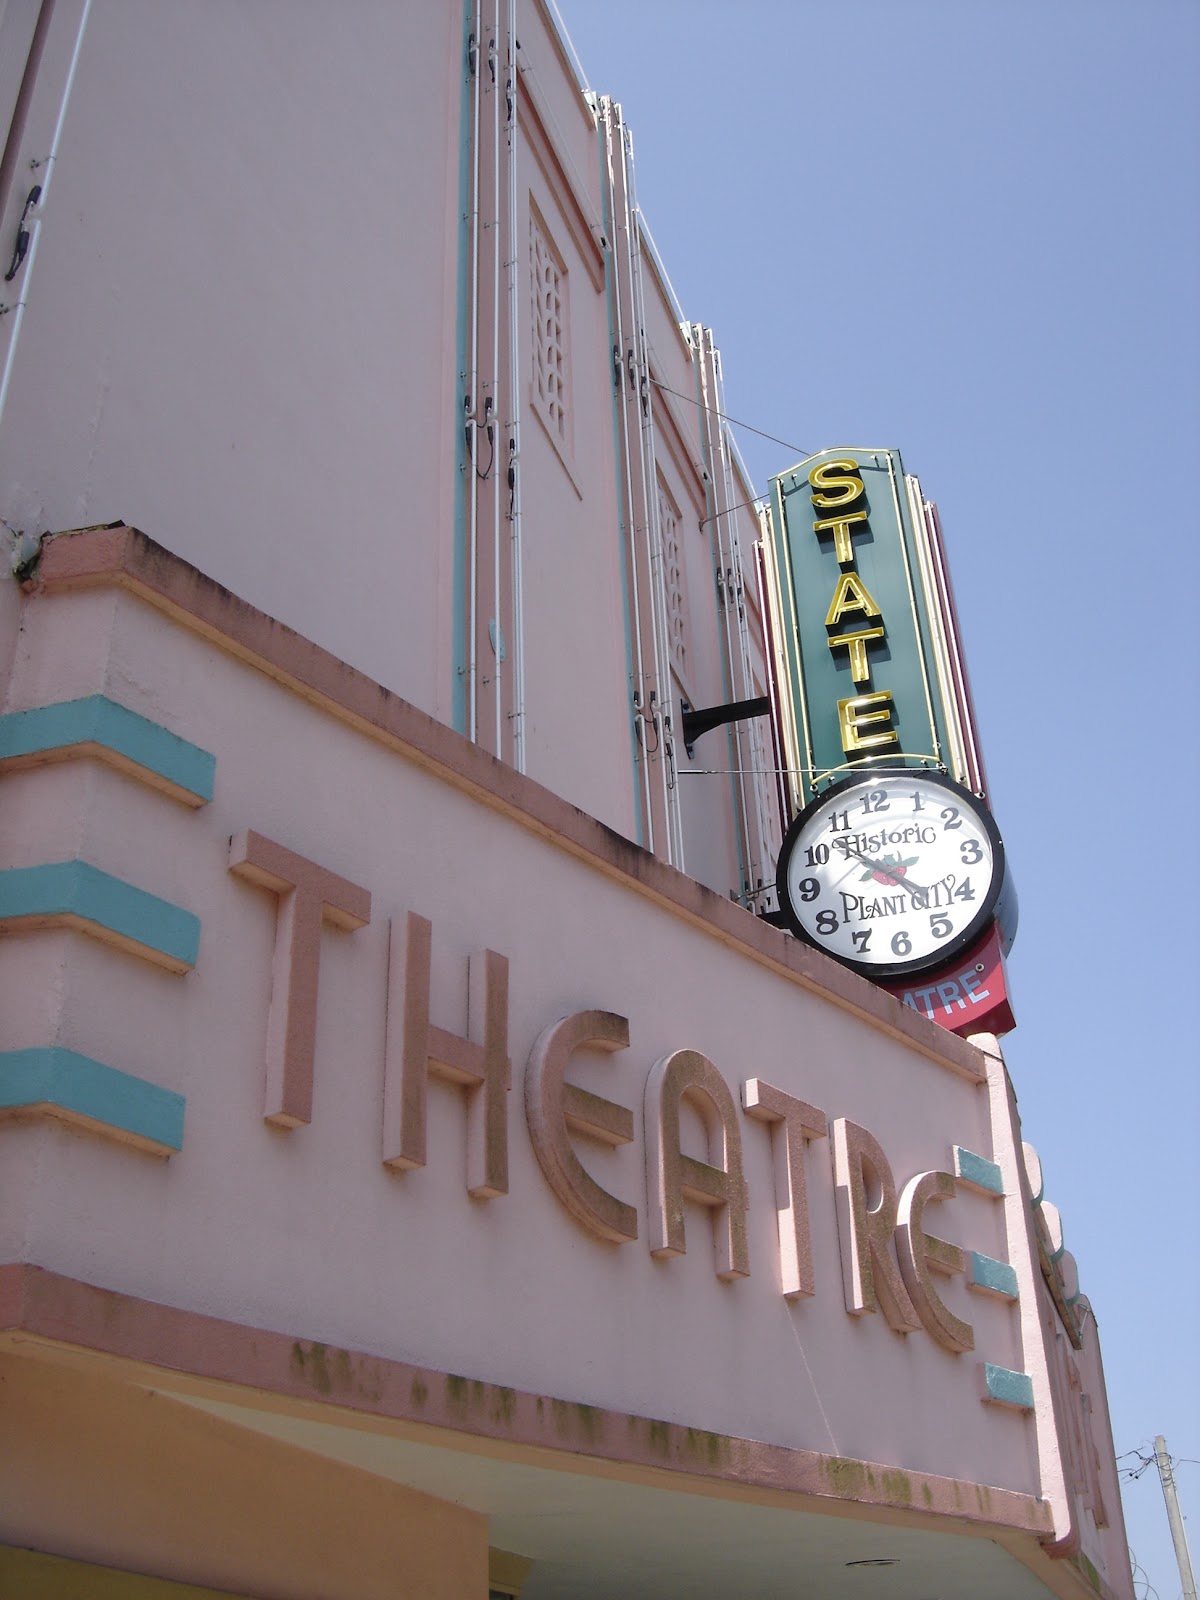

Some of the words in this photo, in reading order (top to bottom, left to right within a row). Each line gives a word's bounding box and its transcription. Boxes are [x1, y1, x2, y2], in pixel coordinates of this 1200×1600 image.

[808, 458, 897, 752] STATE
[860, 789, 891, 815] 12
[909, 791, 926, 812] 1
[828, 810, 852, 833] 11
[940, 807, 963, 831] 2
[831, 823, 937, 860] Historic
[960, 839, 984, 865] 3
[804, 843, 830, 868] 10
[798, 877, 821, 902] 9
[839, 891, 906, 924] PLANT
[910, 874, 957, 911] CITY
[954, 876, 976, 902] 4
[815, 909, 840, 936] 8
[929, 912, 954, 939] 5
[851, 928, 873, 954] 7
[890, 931, 913, 957] 6
[228, 828, 976, 1354] THEATRE
